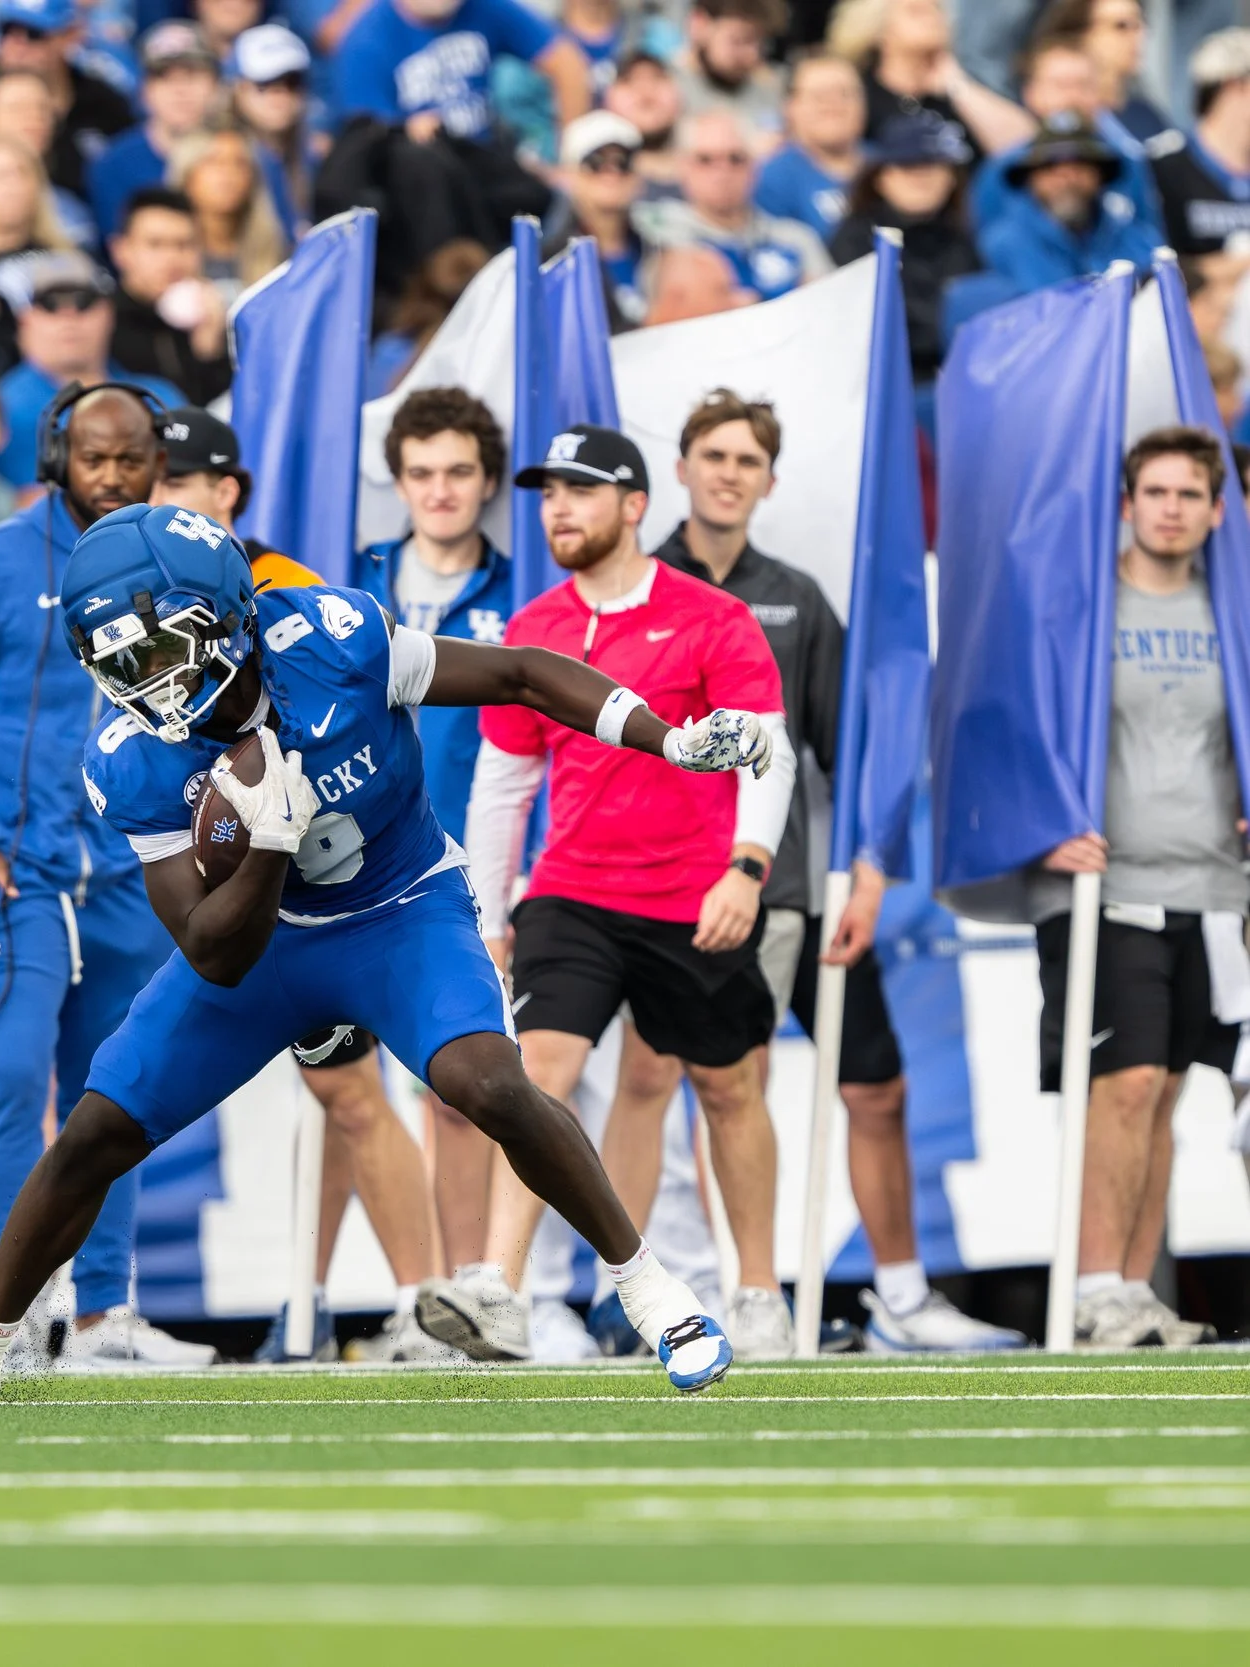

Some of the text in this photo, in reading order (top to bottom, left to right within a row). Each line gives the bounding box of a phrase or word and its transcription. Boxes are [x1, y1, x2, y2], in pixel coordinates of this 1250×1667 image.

[165, 509, 228, 551] UK
[264, 613, 314, 653] 8
[1119, 629, 1218, 660] ENTUCK
